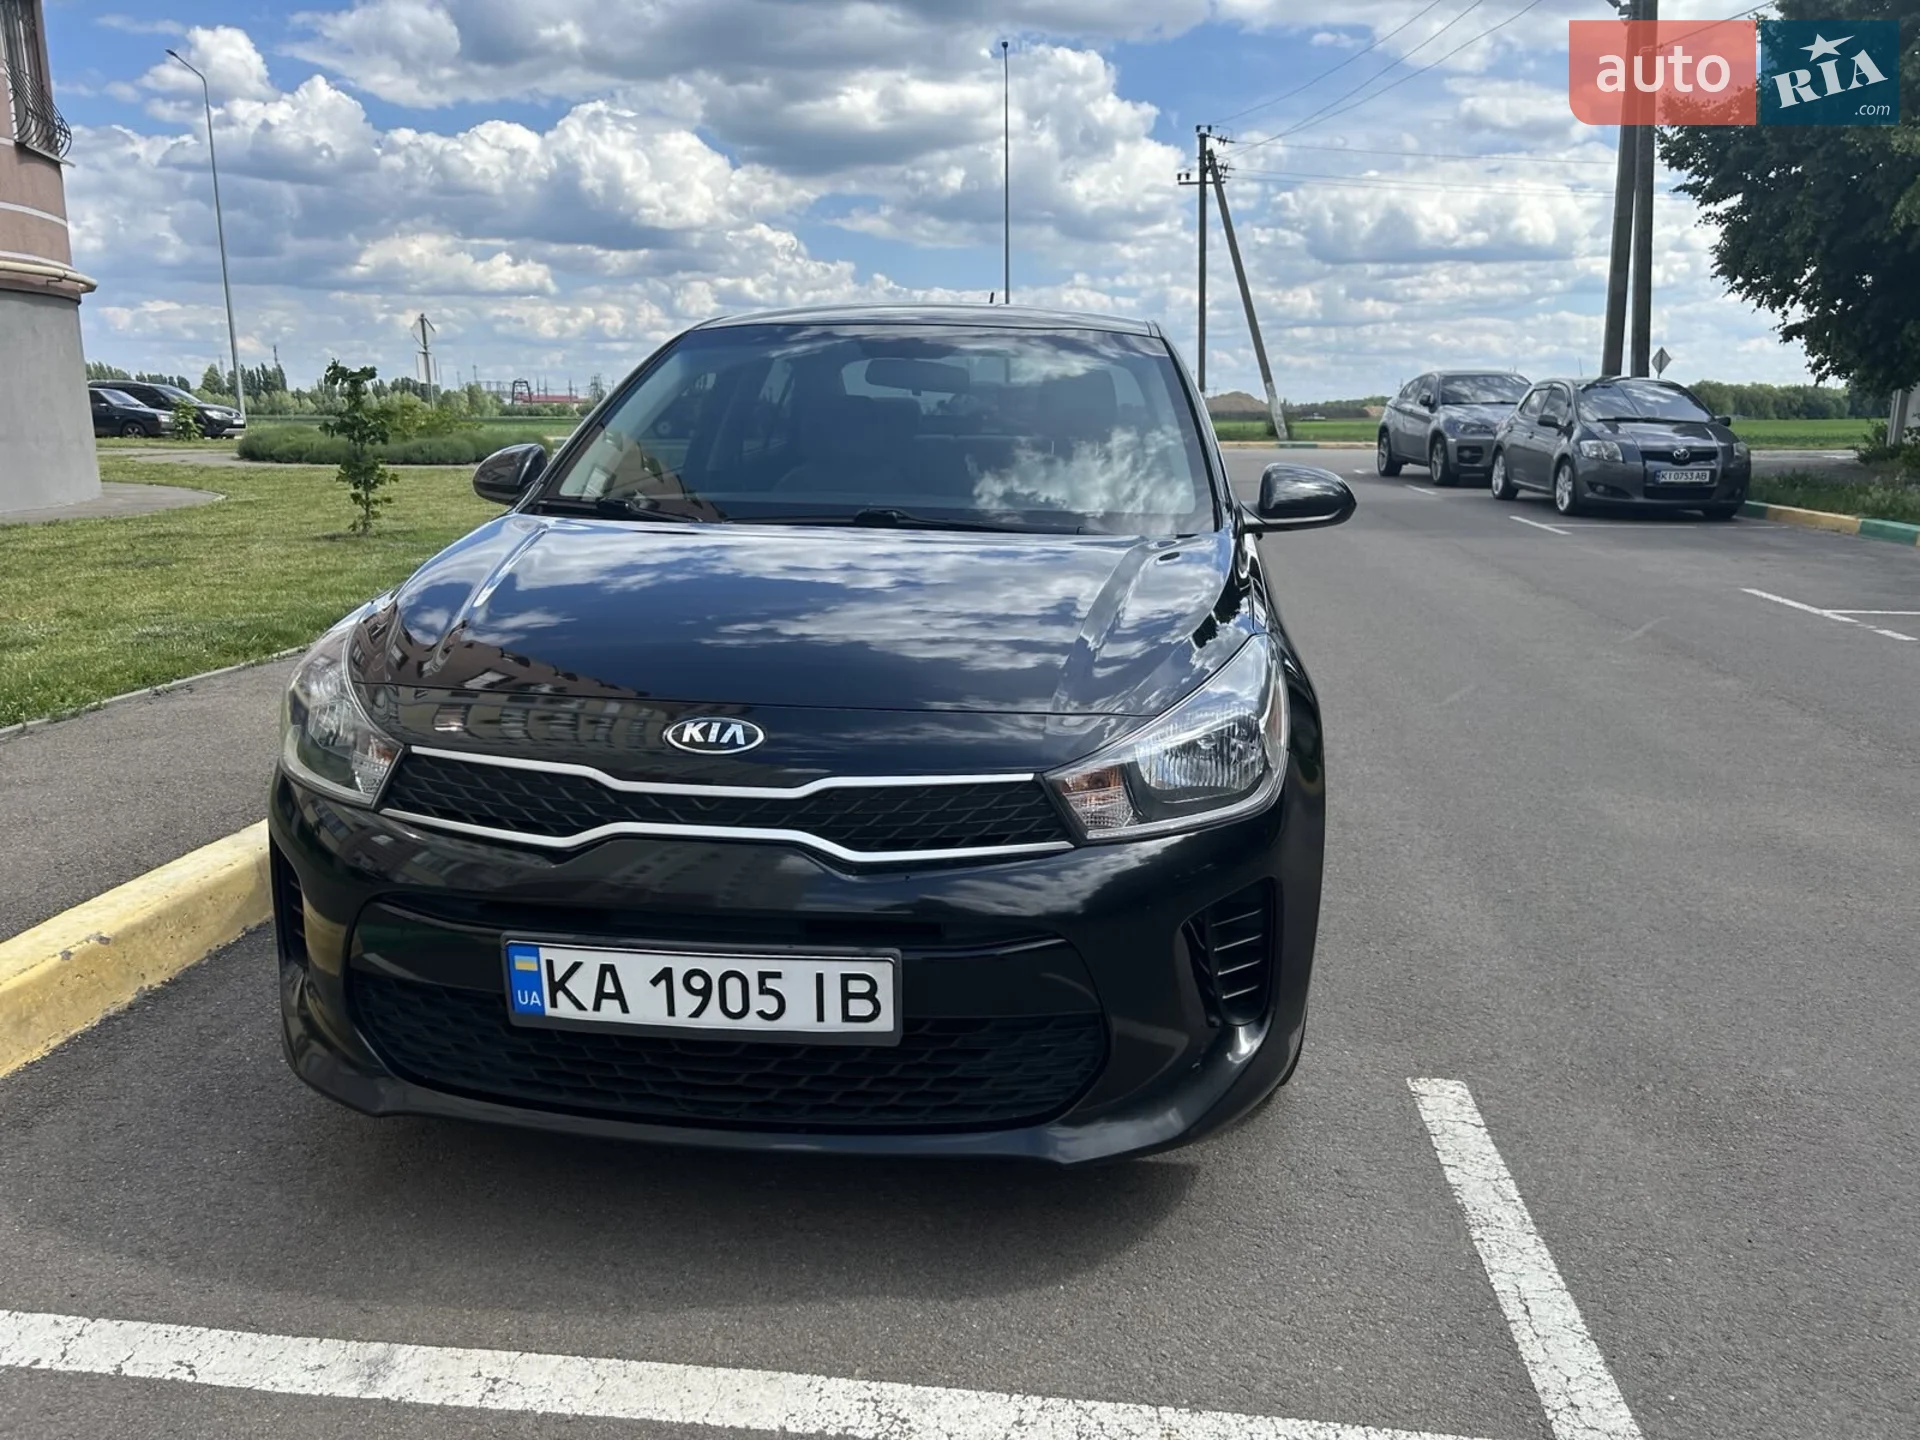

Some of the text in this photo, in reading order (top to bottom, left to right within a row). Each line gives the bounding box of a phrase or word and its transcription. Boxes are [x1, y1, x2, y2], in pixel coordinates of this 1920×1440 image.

[682, 722, 745, 745] KIA
[517, 988, 542, 1007] UA
[545, 958, 882, 1023] KA 1905 IB
